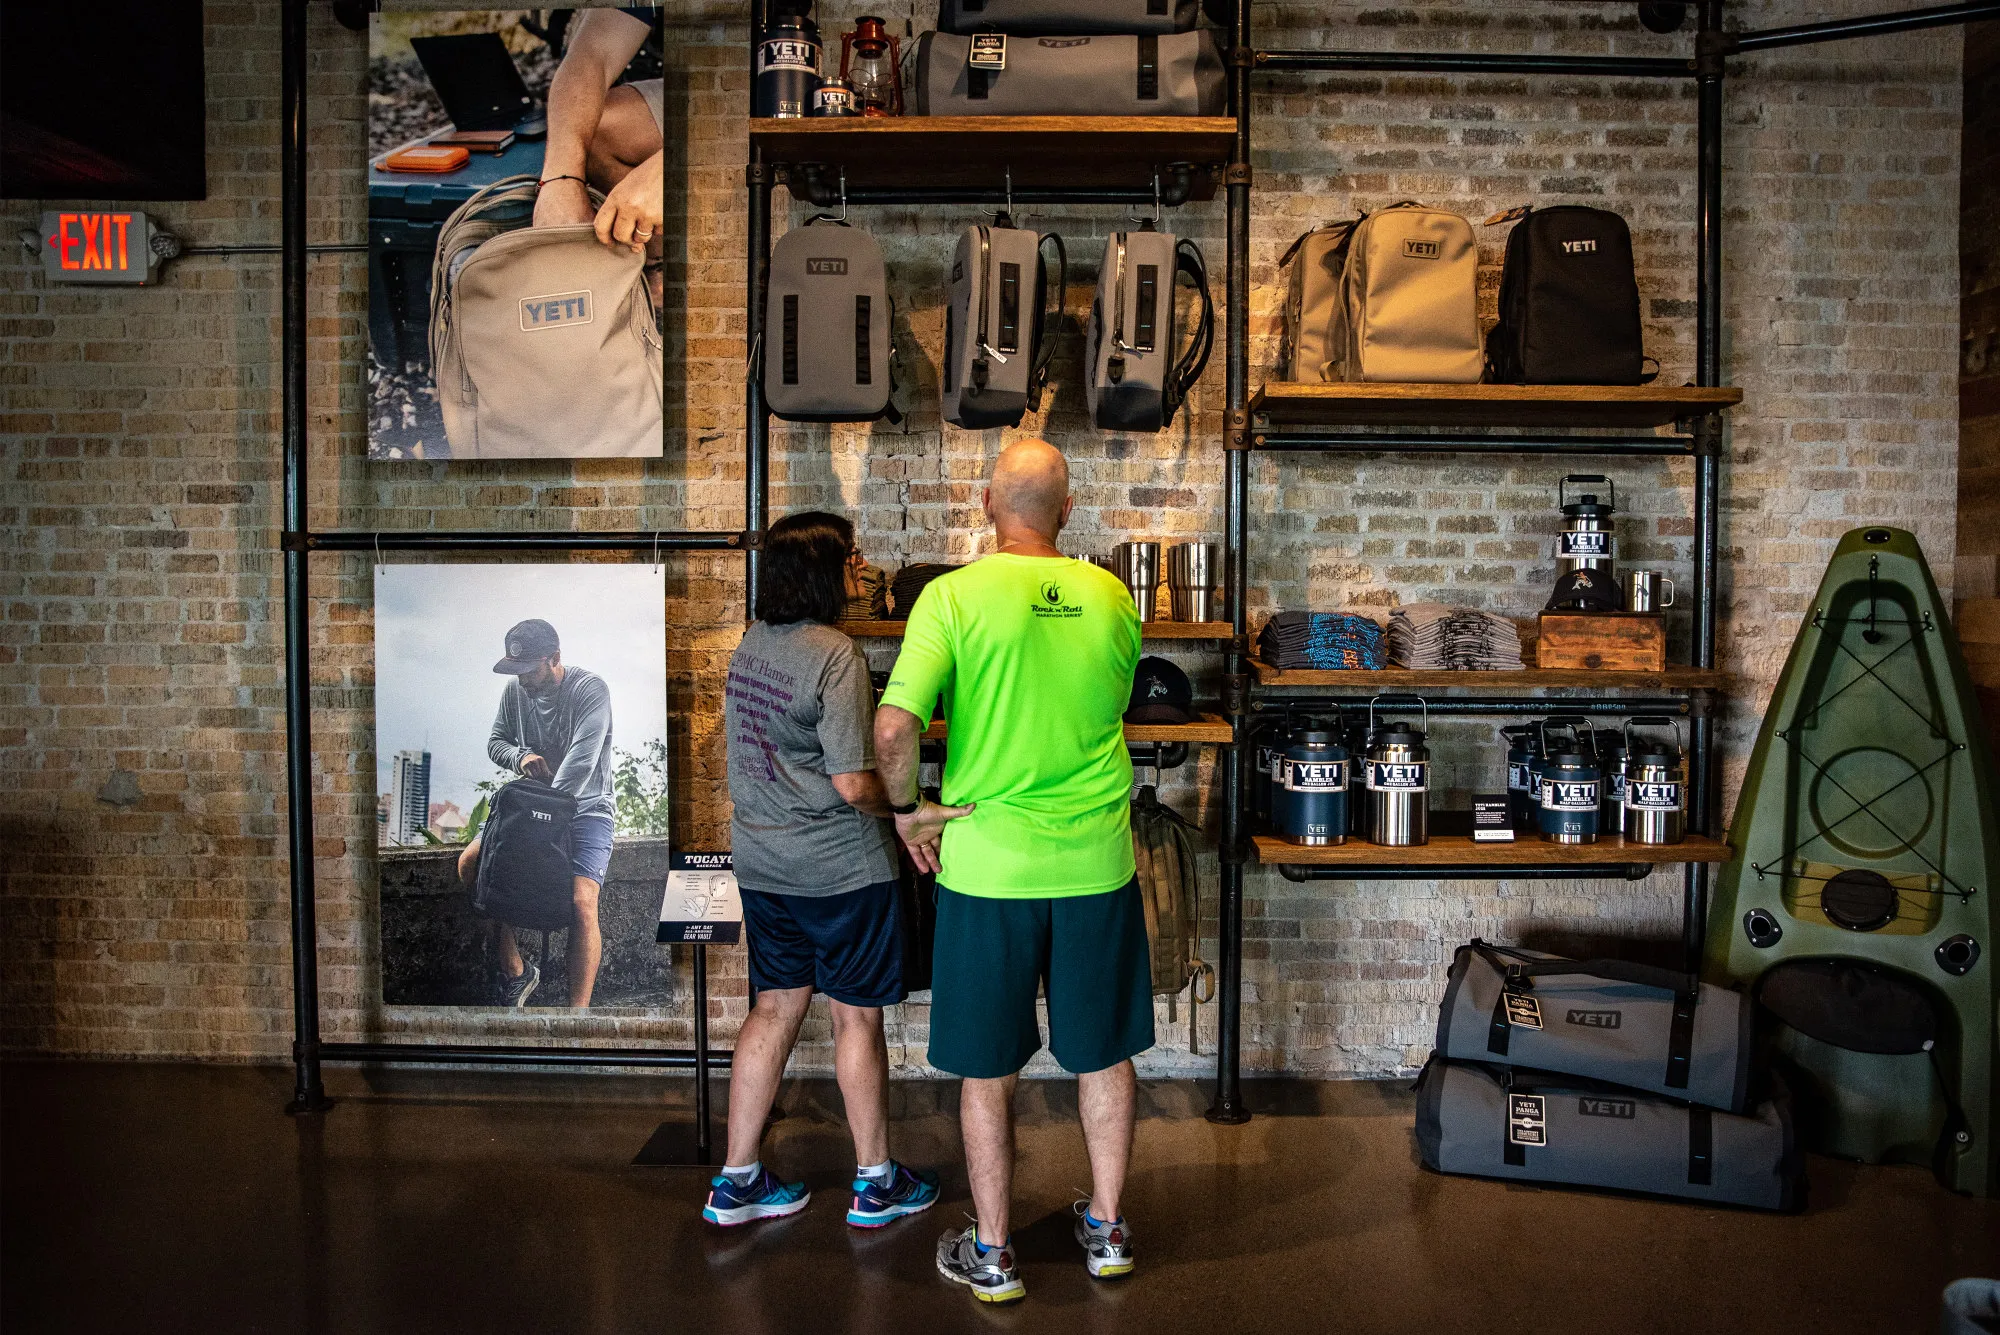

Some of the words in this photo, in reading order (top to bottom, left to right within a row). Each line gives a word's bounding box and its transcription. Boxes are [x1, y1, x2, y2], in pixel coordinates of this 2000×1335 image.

[770, 42, 810, 57] YETI
[823, 92, 846, 102] YETI
[59, 213, 131, 270] EXIT
[1407, 242, 1436, 255] YETI
[1562, 240, 1596, 253] YETI
[810, 261, 844, 272] YETI
[526, 298, 584, 324] YETI
[1566, 533, 1604, 545] YETI
[760, 660, 795, 687] Hamot
[1298, 764, 1337, 778] YETI
[1380, 764, 1419, 778] YETI
[1557, 784, 1594, 796] YETI
[1636, 783, 1674, 797] YETI
[532, 810, 551, 820] YETI
[1572, 1012, 1616, 1026] YETI
[1584, 1100, 1630, 1115] YETI
